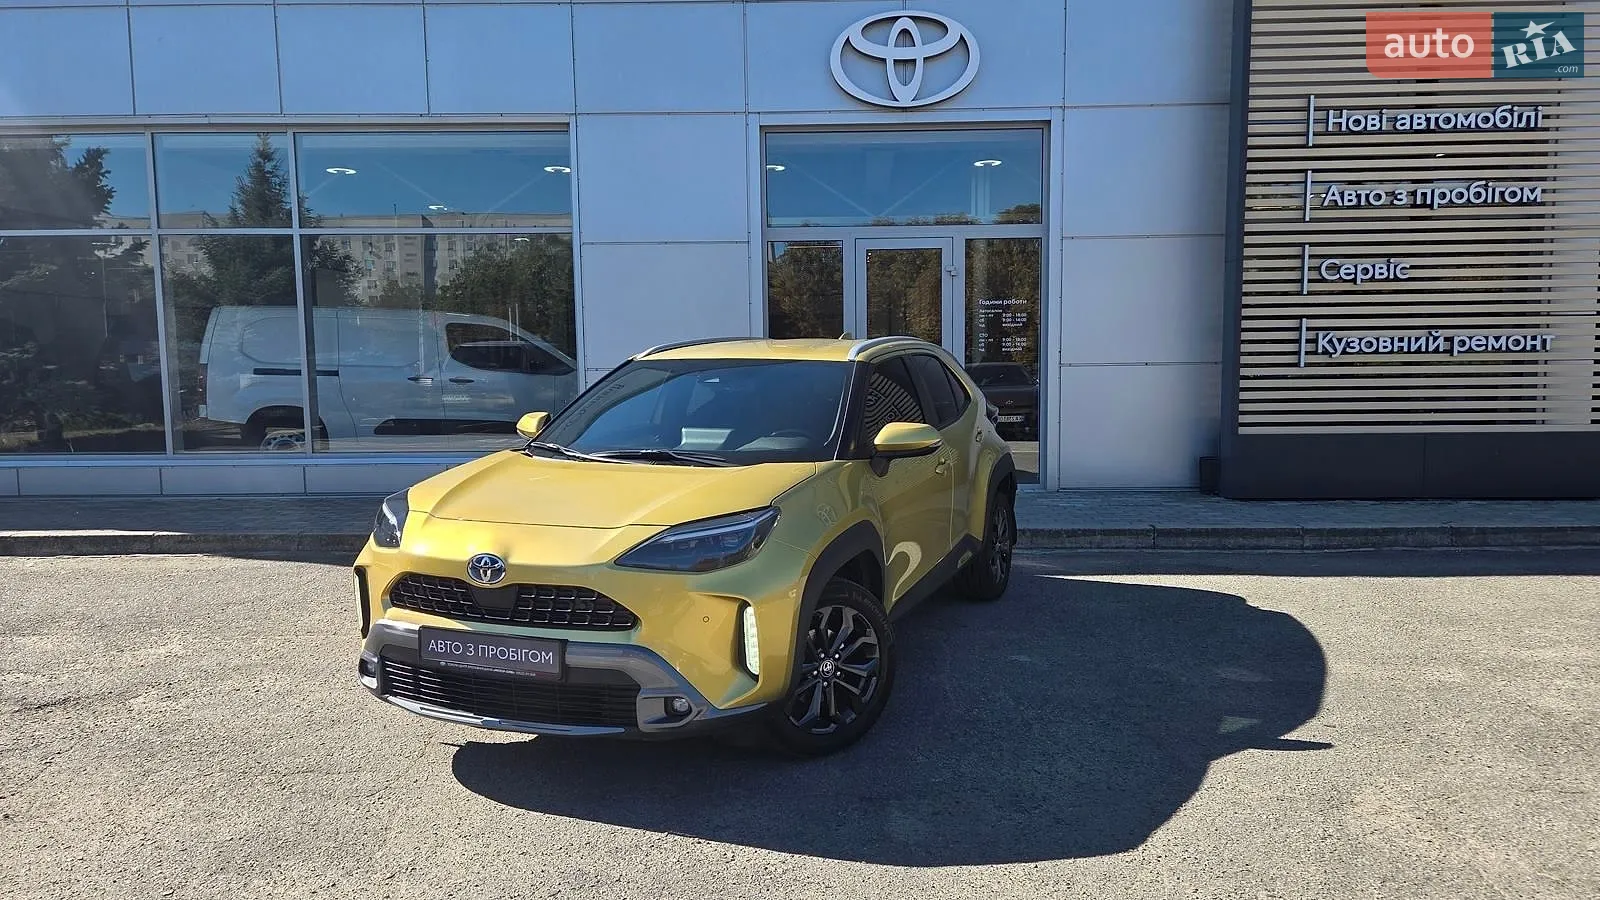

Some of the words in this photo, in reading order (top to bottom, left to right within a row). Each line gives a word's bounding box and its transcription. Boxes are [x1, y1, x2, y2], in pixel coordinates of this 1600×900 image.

[1327, 109, 1388, 132] Нові
[1395, 105, 1543, 131] автомобілі
[1322, 185, 1386, 207] Авто
[1393, 188, 1408, 206] з
[1416, 181, 1542, 209] пробігом
[1320, 259, 1410, 285] Сервіс
[1317, 330, 1444, 358] Кузовний
[1452, 333, 1555, 357] ремонт
[428, 639, 463, 655] АВТО
[478, 645, 553, 665] ПРОБІГОМ
